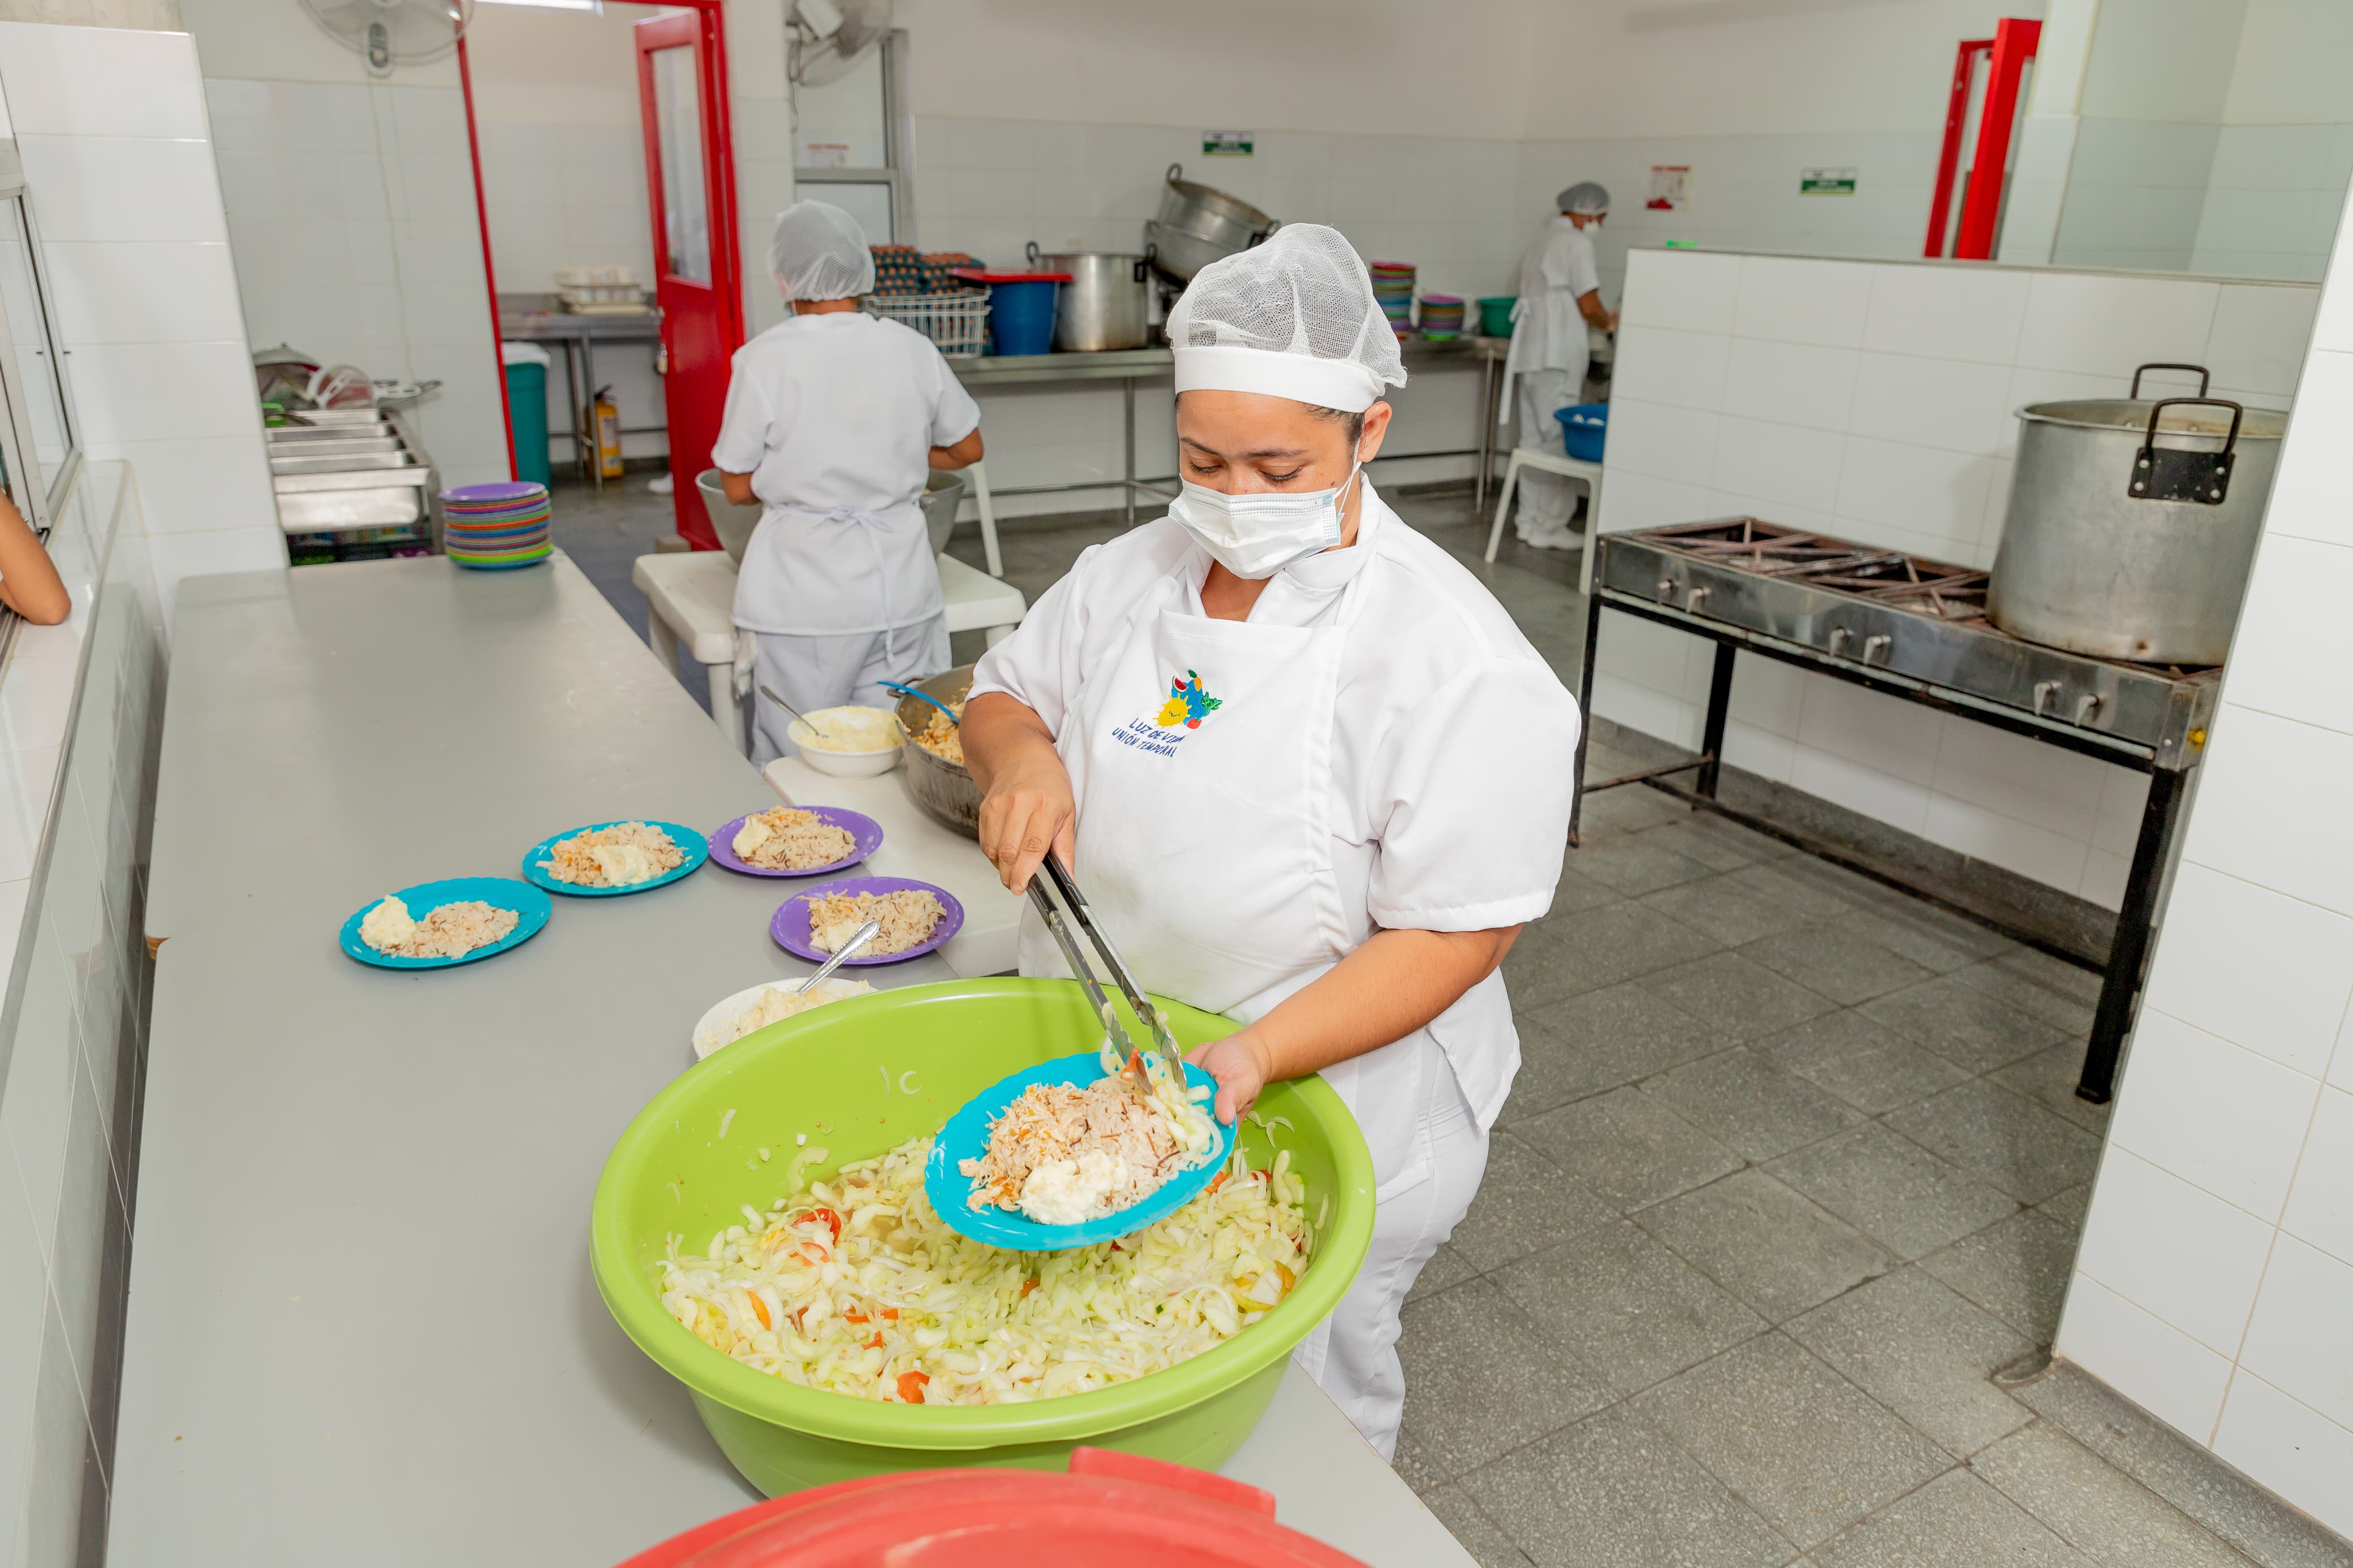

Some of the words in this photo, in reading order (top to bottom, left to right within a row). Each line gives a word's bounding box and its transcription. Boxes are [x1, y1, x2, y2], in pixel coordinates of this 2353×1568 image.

[1129, 718, 1153, 734] LUZ
[1148, 730, 1165, 739] DE
[1112, 727, 1140, 746] UNIÓN
[1136, 741, 1177, 757] TEMPORAL
